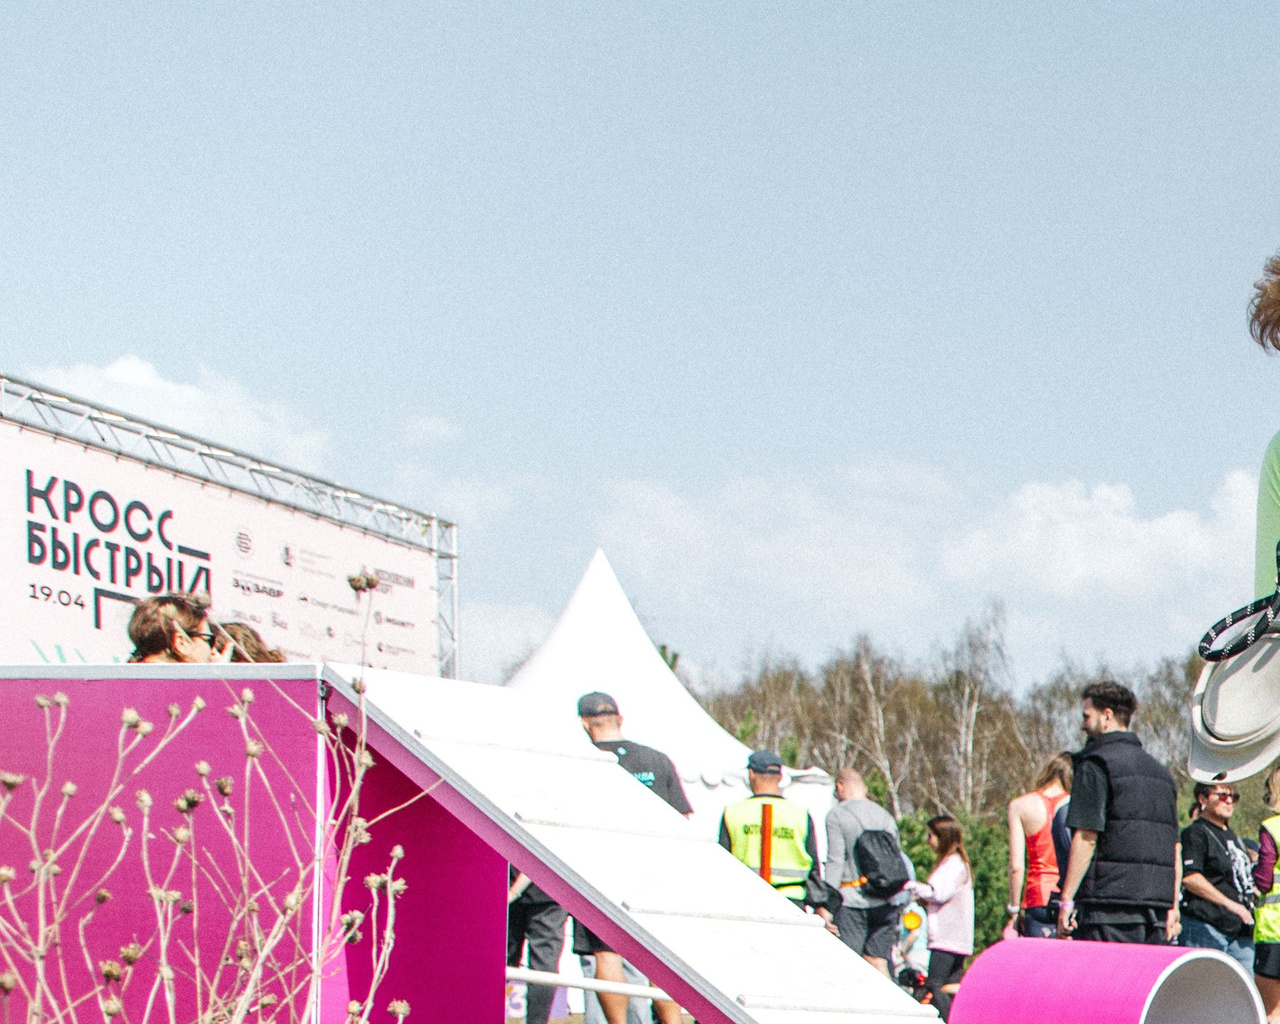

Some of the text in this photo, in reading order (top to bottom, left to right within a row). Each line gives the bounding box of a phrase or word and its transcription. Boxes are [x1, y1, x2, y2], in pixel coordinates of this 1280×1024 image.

[26, 469, 173, 551] КРОСС
[27, 520, 211, 605] БЫСТРЫЙ
[29, 583, 86, 609] 19.04
